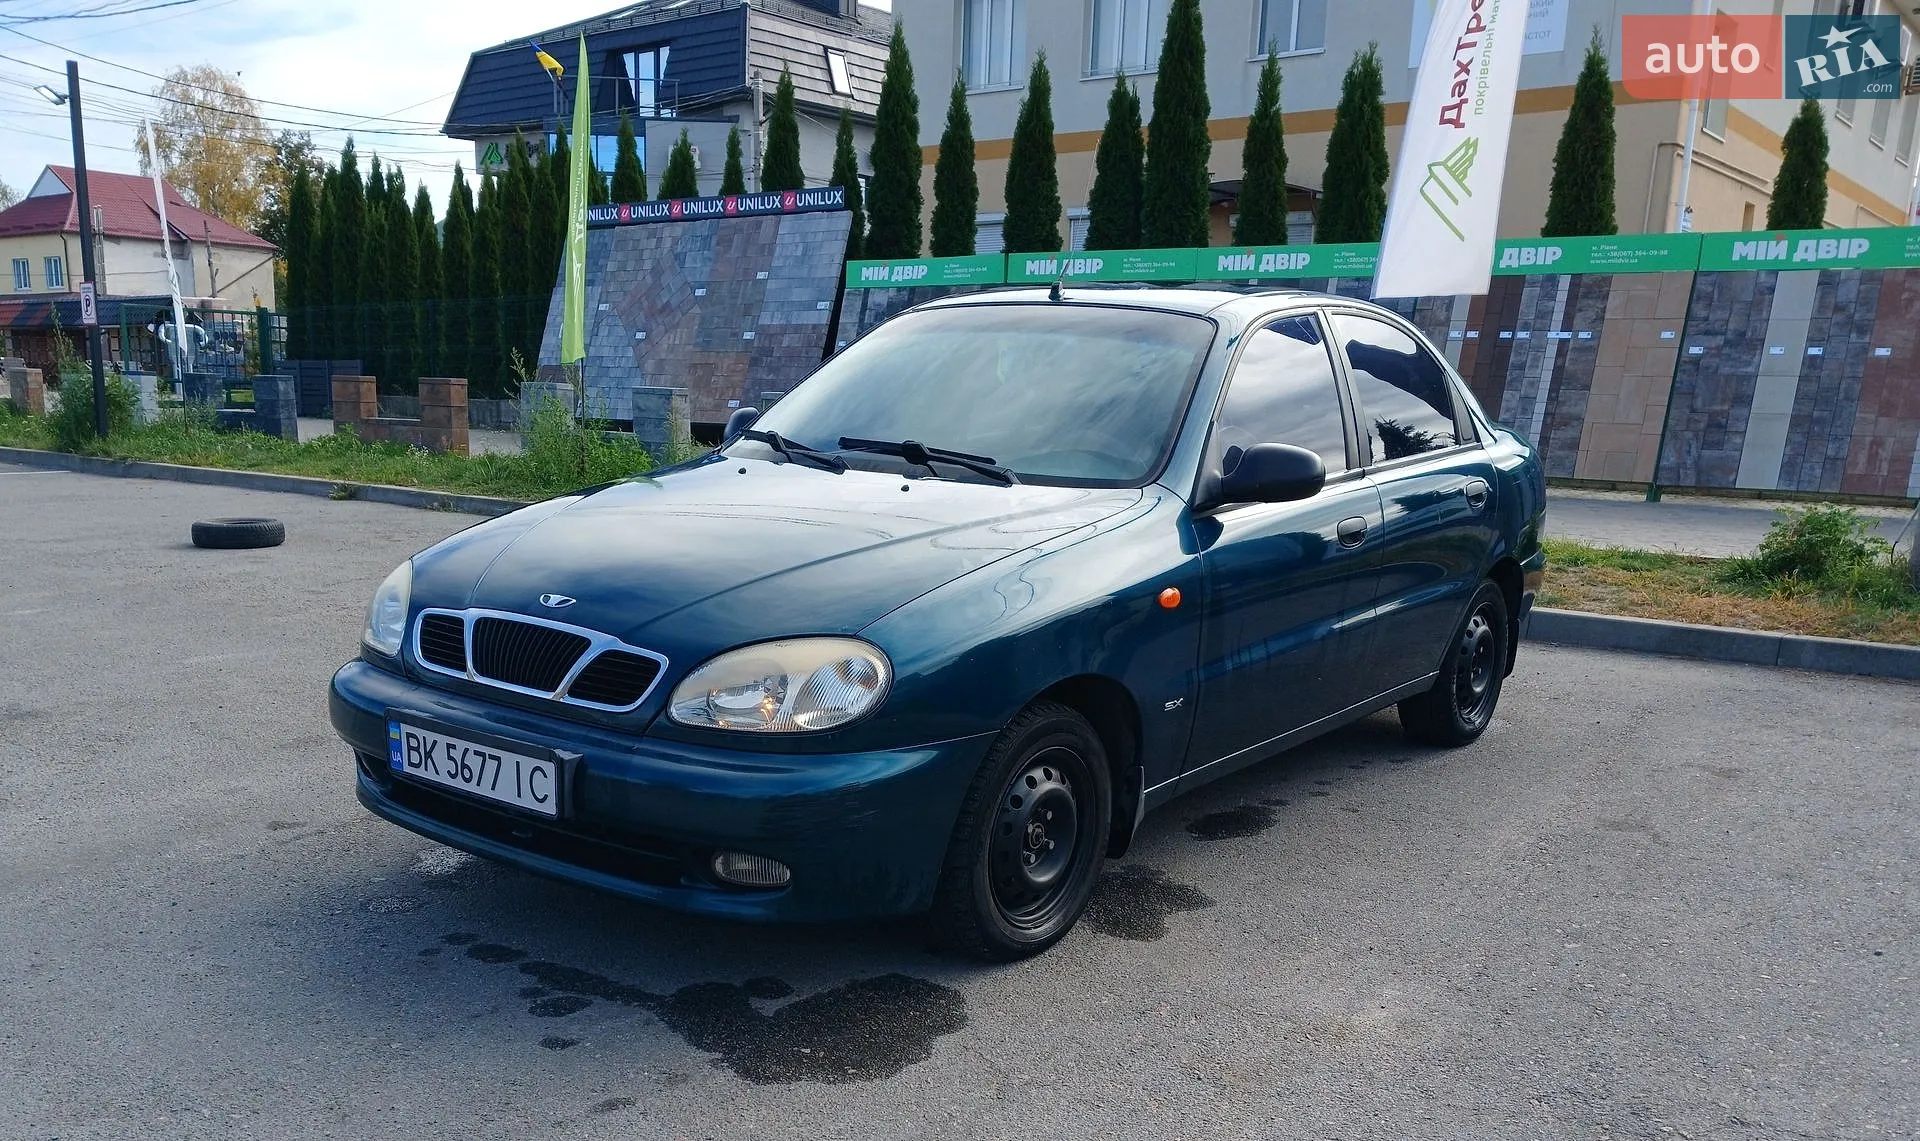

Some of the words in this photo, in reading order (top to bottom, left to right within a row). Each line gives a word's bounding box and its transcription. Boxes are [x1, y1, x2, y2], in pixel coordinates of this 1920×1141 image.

[1474, 27, 1495, 115] покрівельні
[587, 207, 619, 221] NILUX
[630, 203, 670, 219] UNILUX
[682, 199, 724, 215] UNILUX
[738, 195, 781, 212] UNILUX
[796, 190, 843, 207] UNILUX
[1499, 246, 1562, 268] ДВІР
[1732, 234, 1789, 261] МІЙ
[1792, 238, 1871, 262] ДВІР
[861, 262, 889, 281] МІЙ
[891, 264, 928, 281] ДВІР
[1026, 256, 1057, 275] МІЙ
[1060, 258, 1104, 277] ДВІР
[1217, 249, 1256, 271] МІЙ
[1259, 253, 1311, 273] ДВІР
[1164, 697, 1184, 711] SX
[391, 750, 402, 763] UA
[405, 731, 440, 776] BK
[445, 742, 501, 791] 5677
[515, 760, 549, 803] IC
